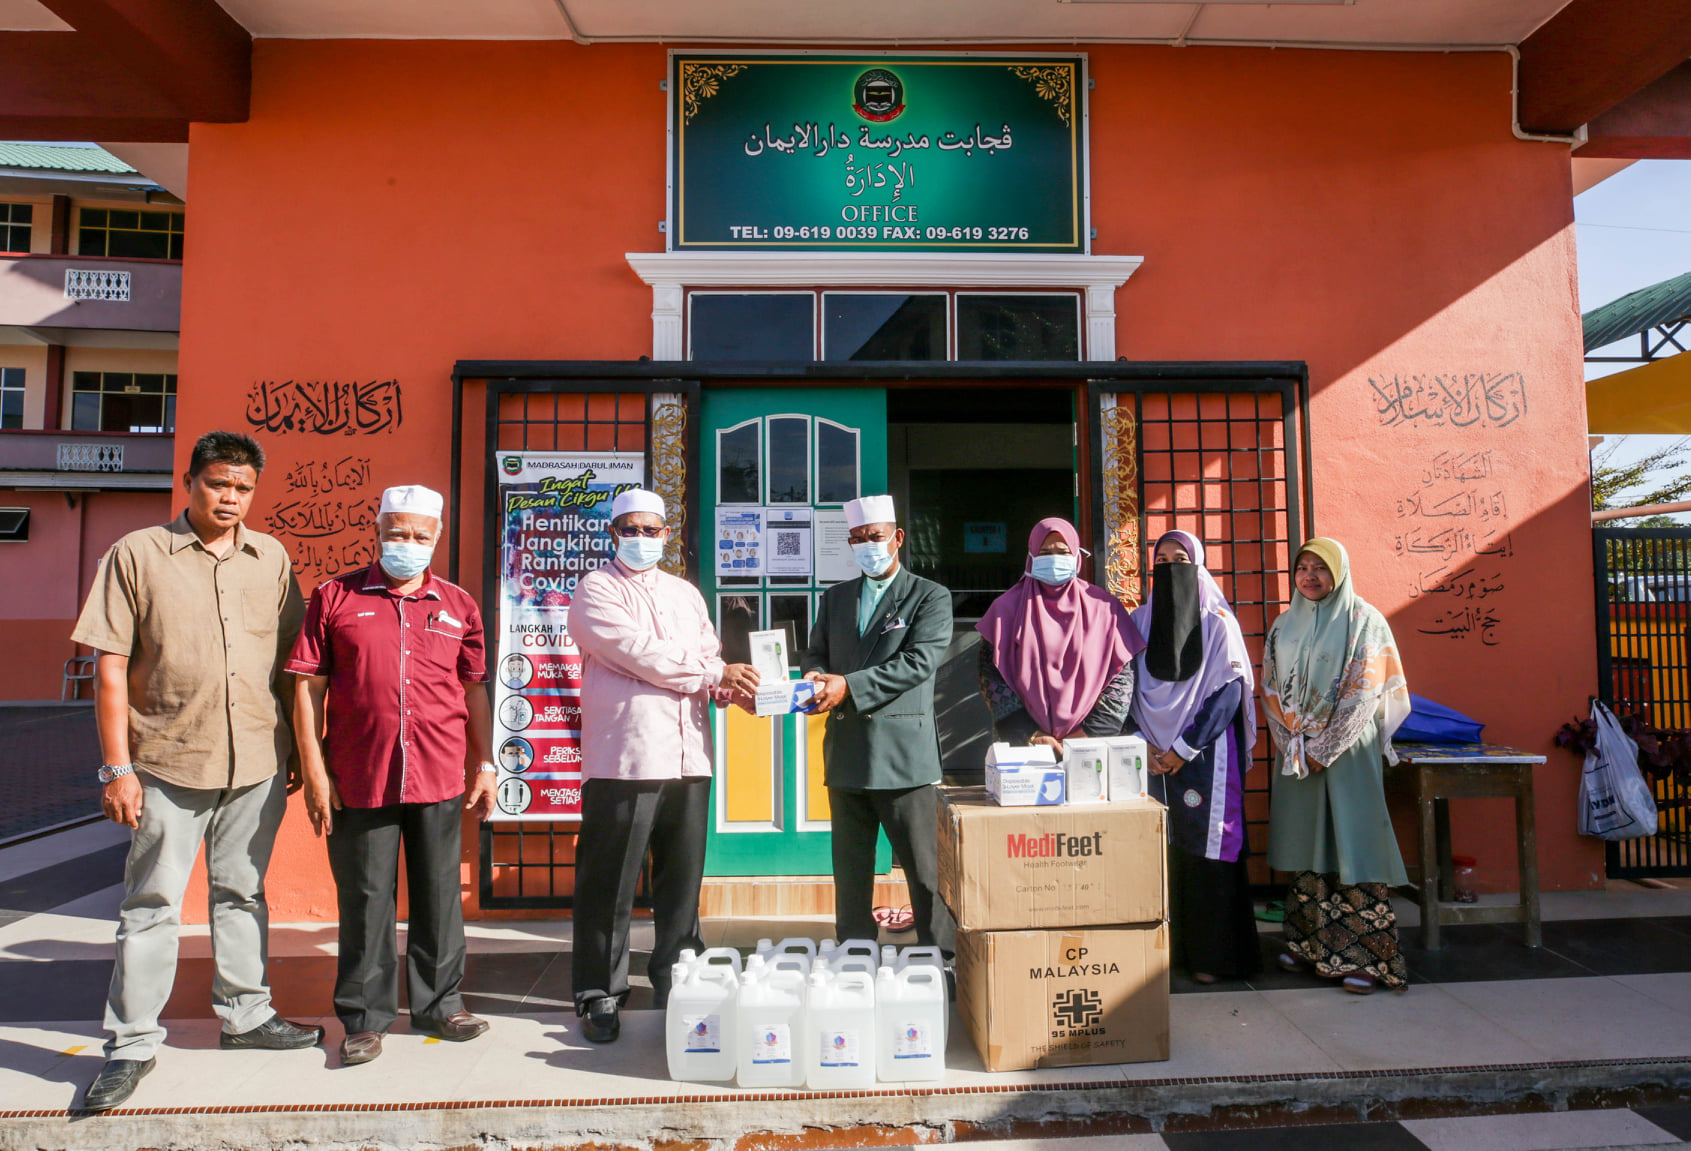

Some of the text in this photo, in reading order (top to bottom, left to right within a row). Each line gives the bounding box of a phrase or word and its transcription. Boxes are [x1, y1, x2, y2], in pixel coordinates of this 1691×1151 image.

[859, 125, 930, 157] مدرسة
[841, 205, 919, 222] OFFICE
[730, 226, 1029, 240] TEL: 09-619 0039 FAX: 09-619 3276
[527, 461, 634, 470] MADRASAH DARUL IMAN
[539, 470, 597, 495] Ingat
[508, 494, 556, 513] Pesan
[559, 489, 608, 508] Cikgu
[522, 514, 612, 532] Hentikan
[517, 533, 616, 555] Jangkitan
[521, 553, 610, 571] Rantaian
[510, 624, 569, 633] LANGKAH P
[537, 670, 564, 680] MUKA
[534, 713, 571, 722] TANGAN
[544, 706, 582, 715] SENTIASA
[550, 745, 581, 755] PERIKS
[550, 795, 581, 805] SETIAP
[1007, 832, 1103, 858] MediFeet
[1023, 860, 1049, 869] Health
[1015, 885, 1043, 893] Carton
[1066, 947, 1089, 961] CP
[1029, 962, 1121, 980] MALAYSIA
[1069, 1027, 1106, 1037] MPLUS
[1031, 1039, 1126, 1053] THE SHIELD OF SAFETY
